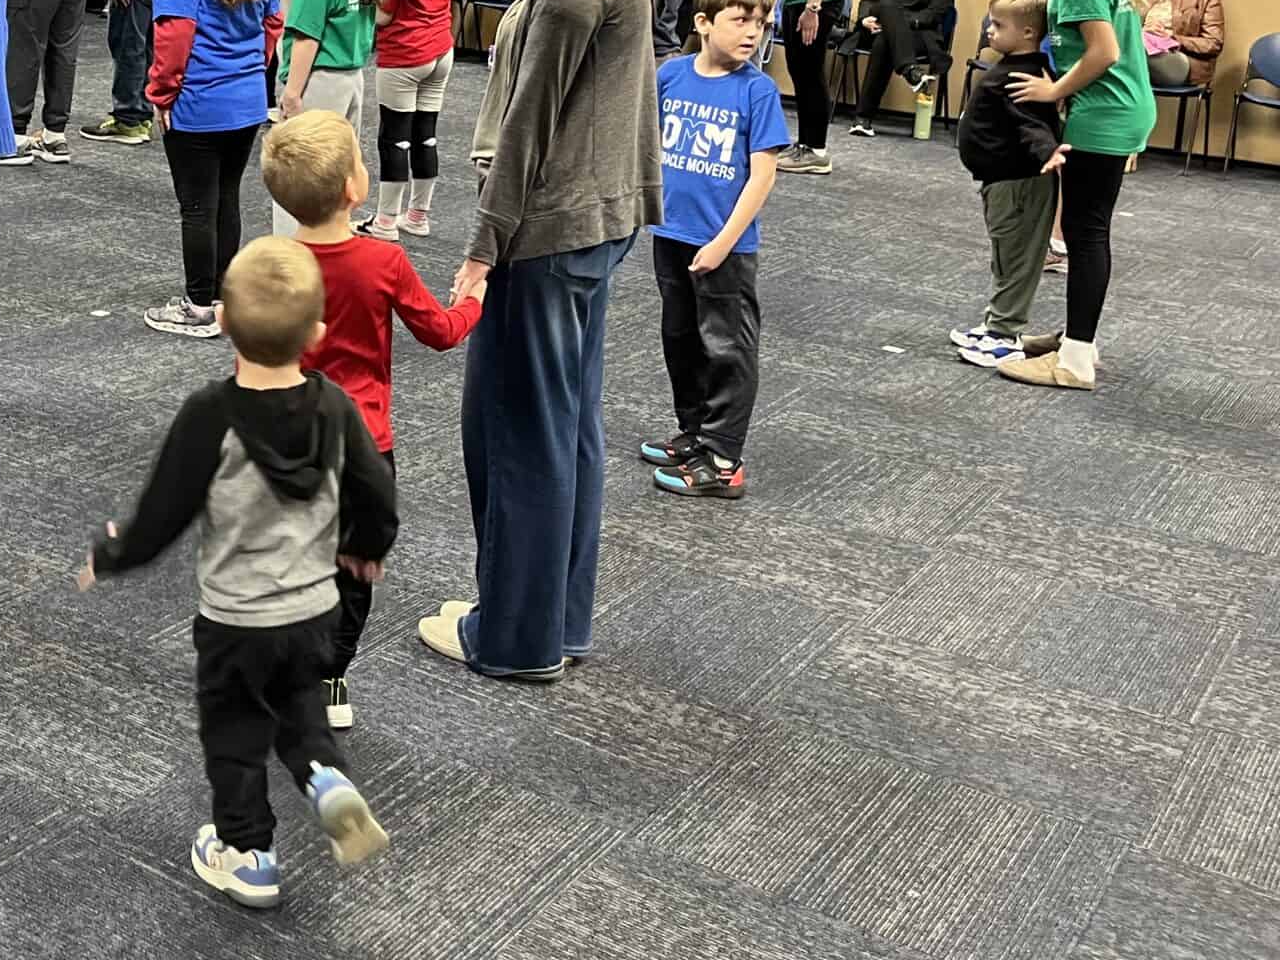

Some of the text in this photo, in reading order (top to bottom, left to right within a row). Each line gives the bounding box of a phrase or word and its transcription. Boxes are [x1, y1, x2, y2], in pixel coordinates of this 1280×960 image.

[663, 98, 739, 126] OPTIMIST
[662, 114, 736, 163] OMM
[686, 157, 736, 180] MOVERS
